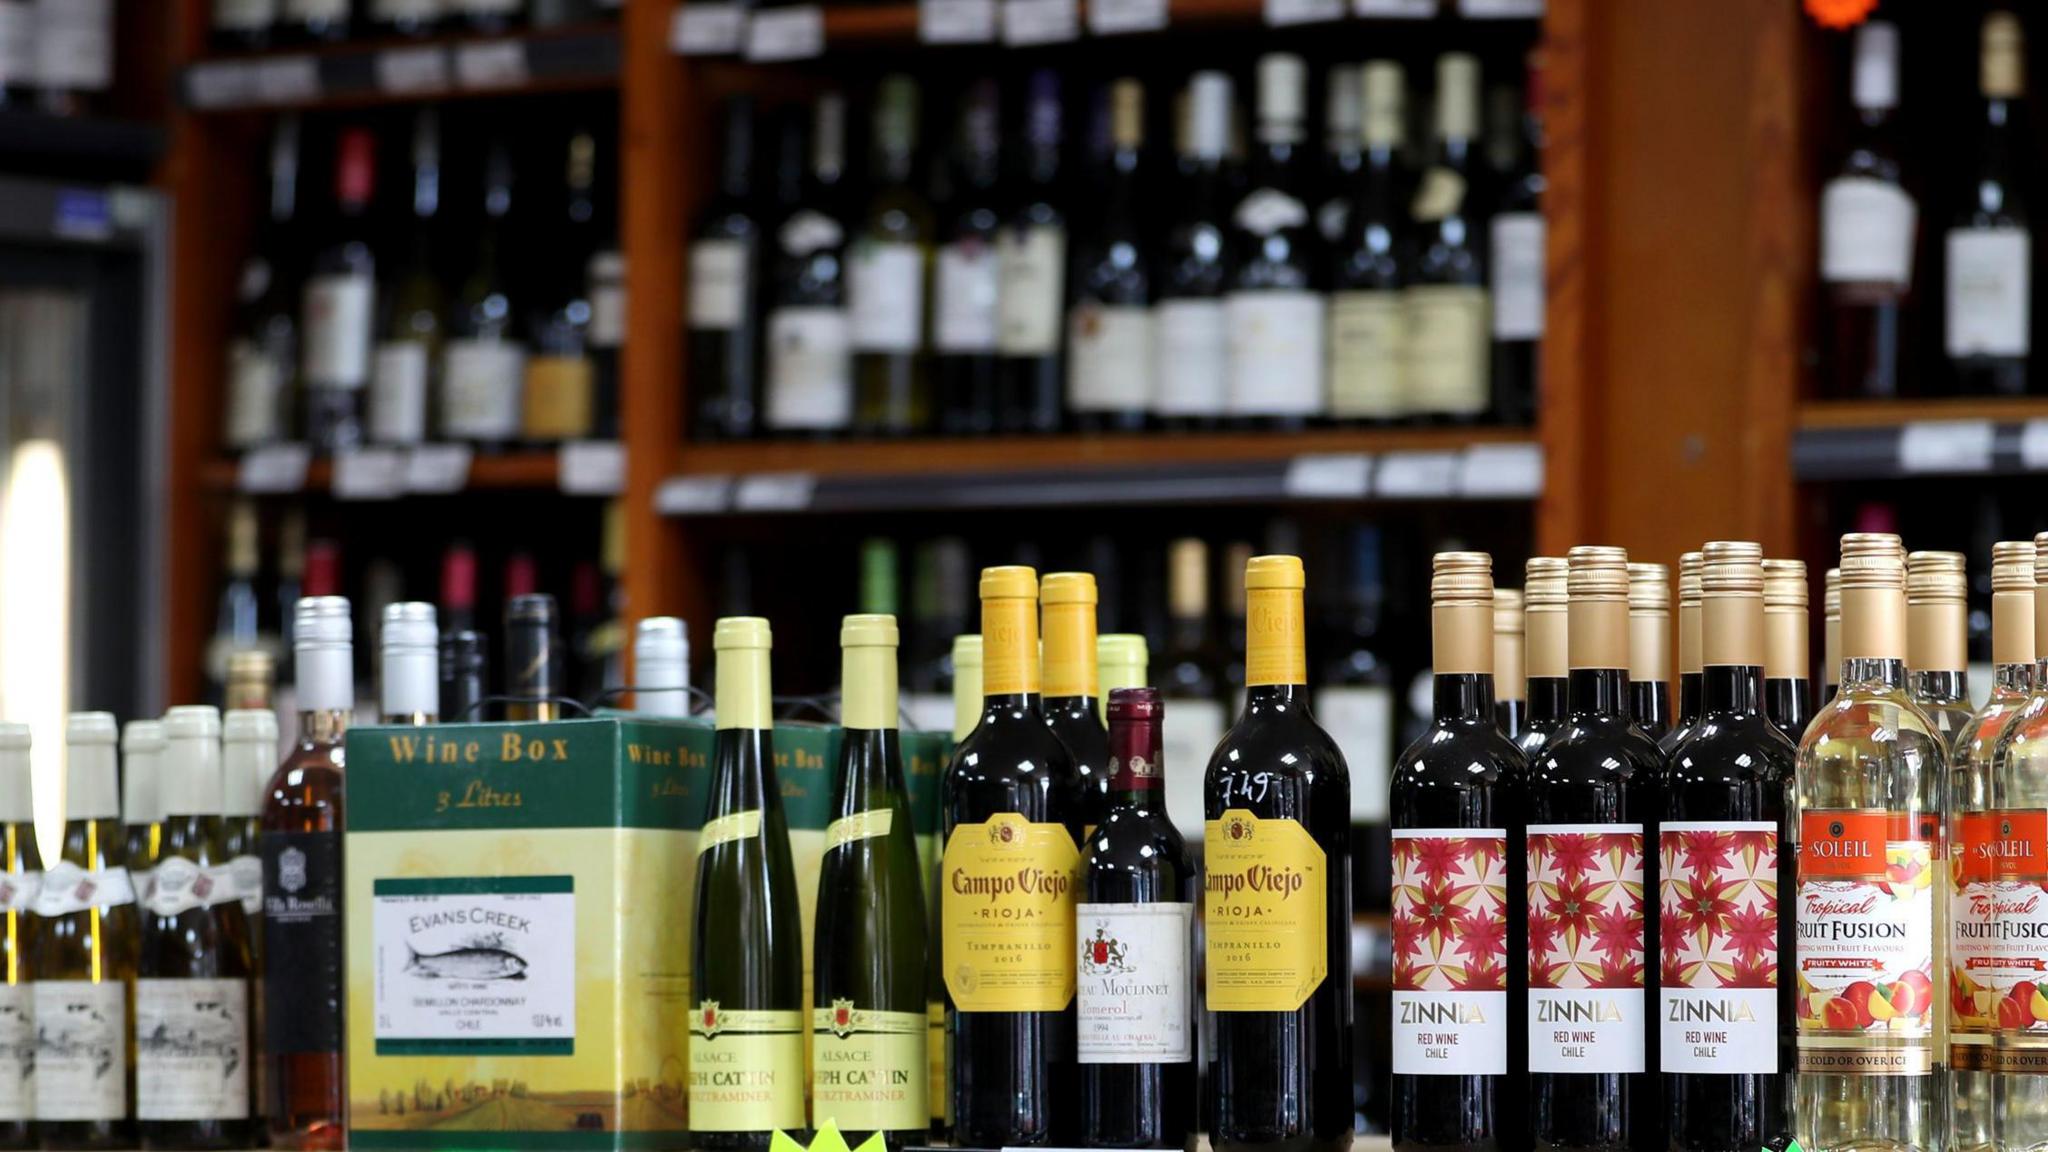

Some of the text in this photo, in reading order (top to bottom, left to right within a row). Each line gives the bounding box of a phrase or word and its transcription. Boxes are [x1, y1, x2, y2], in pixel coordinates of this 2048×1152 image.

[389, 732, 568, 763] Wine Box
[627, 743, 673, 767] Wine
[435, 779, 523, 812] 3 Litres
[1813, 840, 1872, 858] SOLEIL
[952, 866, 1068, 904] Campo Viejo
[1247, 864, 1302, 901] Viejo
[981, 908, 1034, 920] RIOJA
[1217, 906, 1263, 918] RIOJA
[1805, 894, 1877, 921] Tropical
[409, 907, 532, 934] EVANS CREEK
[1832, 920, 1906, 940] FUSION
[1808, 959, 1873, 967] FRUITY WHITE
[1401, 1001, 1486, 1024] ZINNIA
[1537, 1000, 1623, 1023] ZINNIA
[1669, 999, 1756, 1023] ZINNIA
[1417, 1033, 1459, 1045] RED WINE
[1553, 1031, 1595, 1043] RED WINE
[1685, 1031, 1727, 1043] RED WINE
[1425, 1048, 1449, 1059] CHILE
[1561, 1047, 1585, 1058] CHILE
[1693, 1047, 1717, 1058] CHILE
[1810, 1056, 1836, 1066] COLD
[1837, 1056, 1854, 1066] OR
[1856, 1056, 1888, 1066] OVER
